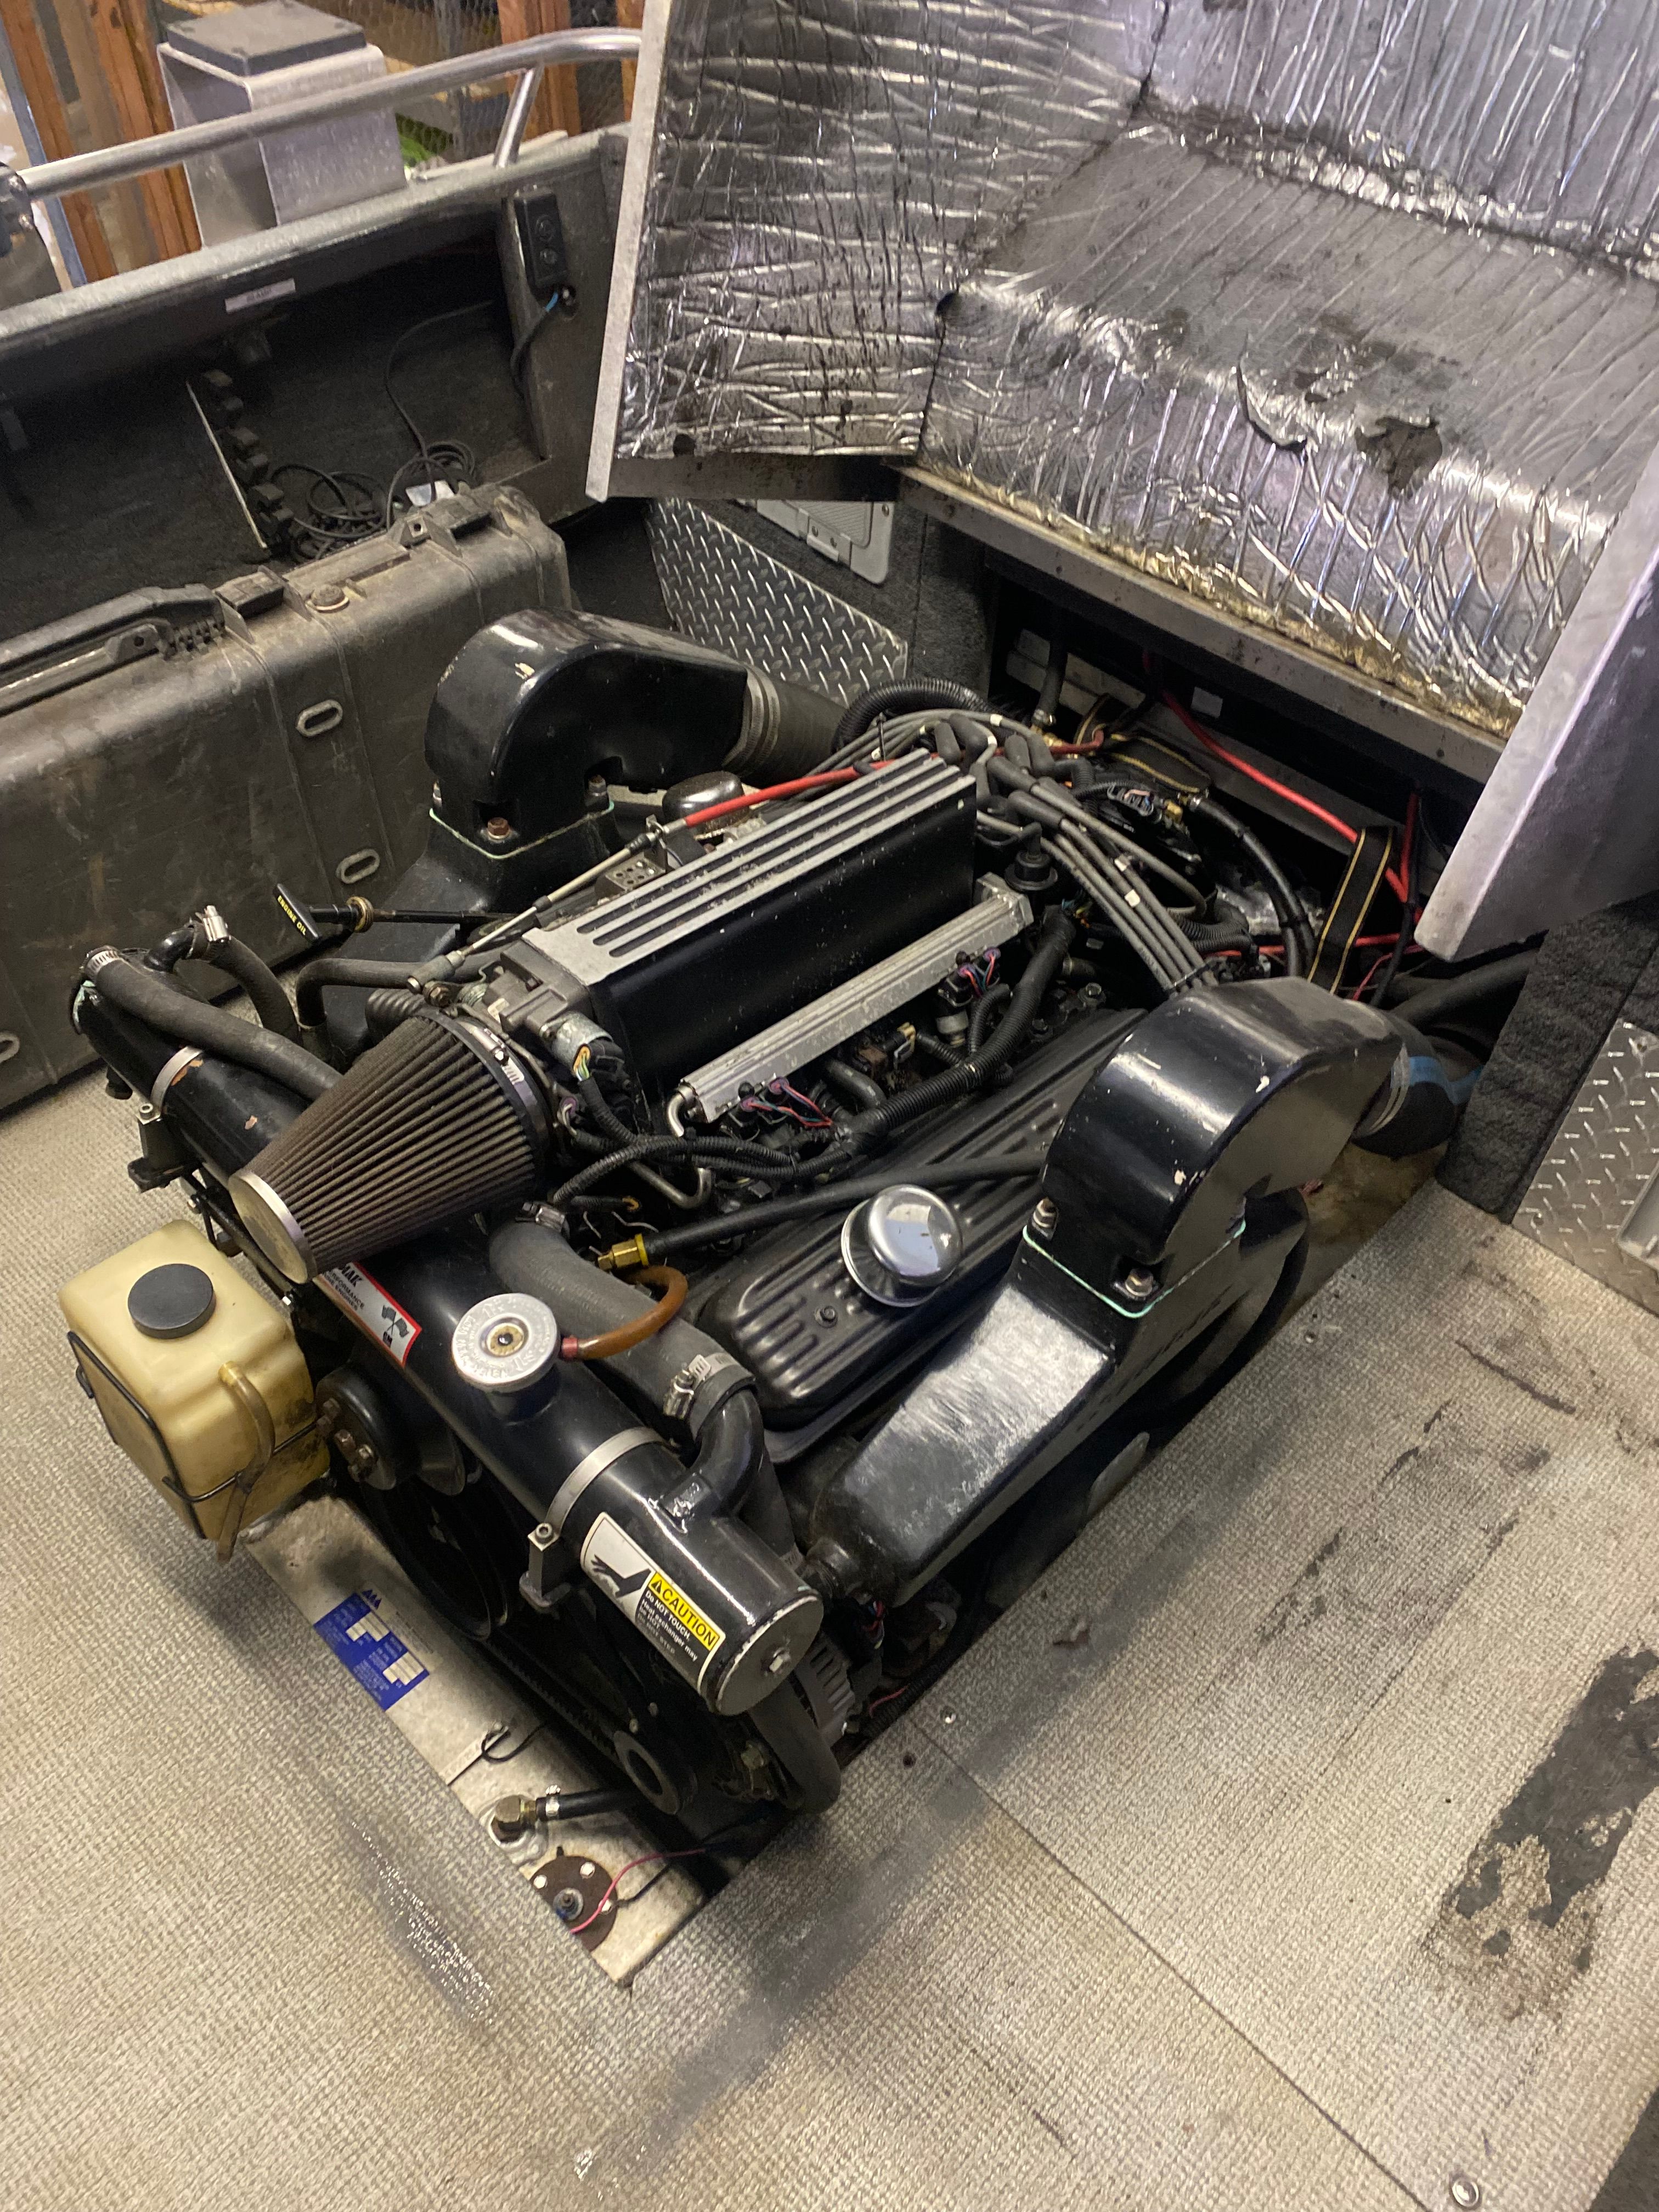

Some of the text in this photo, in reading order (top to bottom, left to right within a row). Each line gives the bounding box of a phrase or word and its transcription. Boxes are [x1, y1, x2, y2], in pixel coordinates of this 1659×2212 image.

[278, 895, 306, 936] ENGINE OIL
[645, 1590, 655, 1603] Do
[654, 1599, 668, 1616] NOT
[662, 1589, 715, 1646] CAUTION
[653, 1613, 685, 1648] exchanger
[685, 1646, 697, 1662] may
